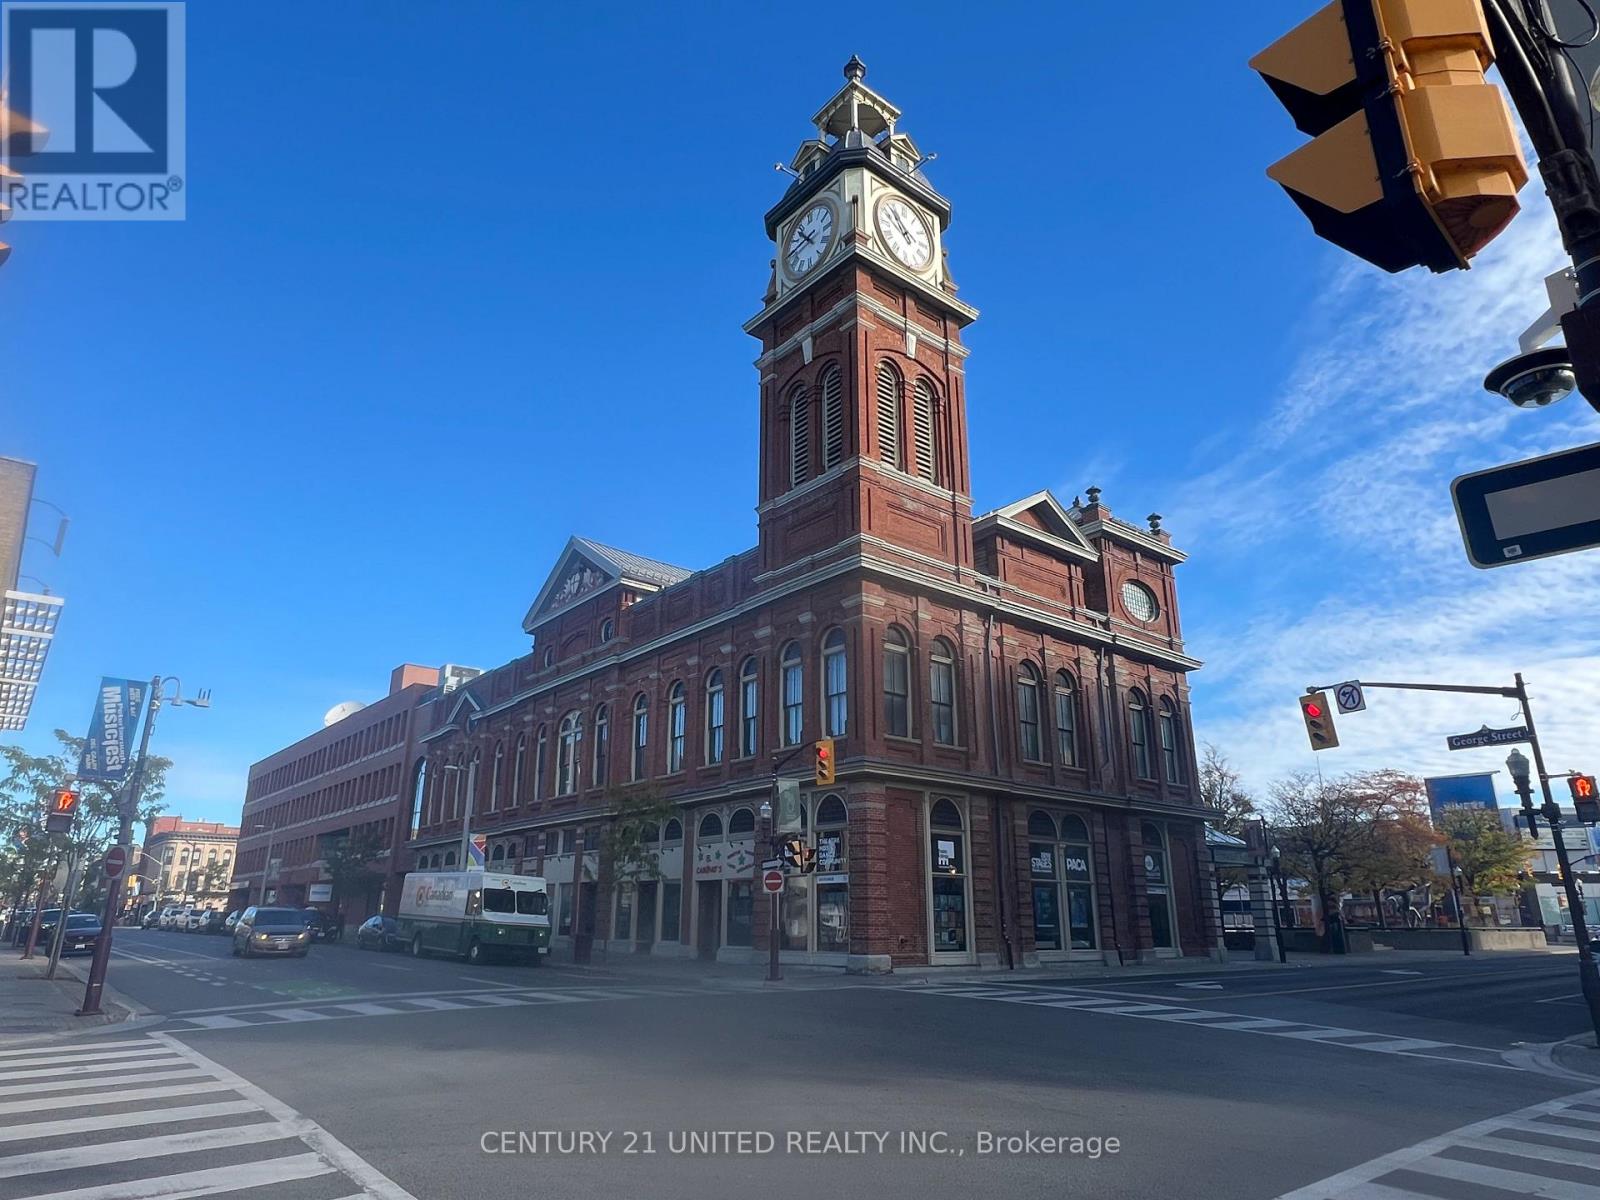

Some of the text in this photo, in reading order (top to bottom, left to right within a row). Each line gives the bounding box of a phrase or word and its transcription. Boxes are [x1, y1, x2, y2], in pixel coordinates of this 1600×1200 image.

[102, 686, 123, 771] Musicfest
[1452, 730, 1523, 746] George Street
[1066, 858, 1087, 872] PACA
